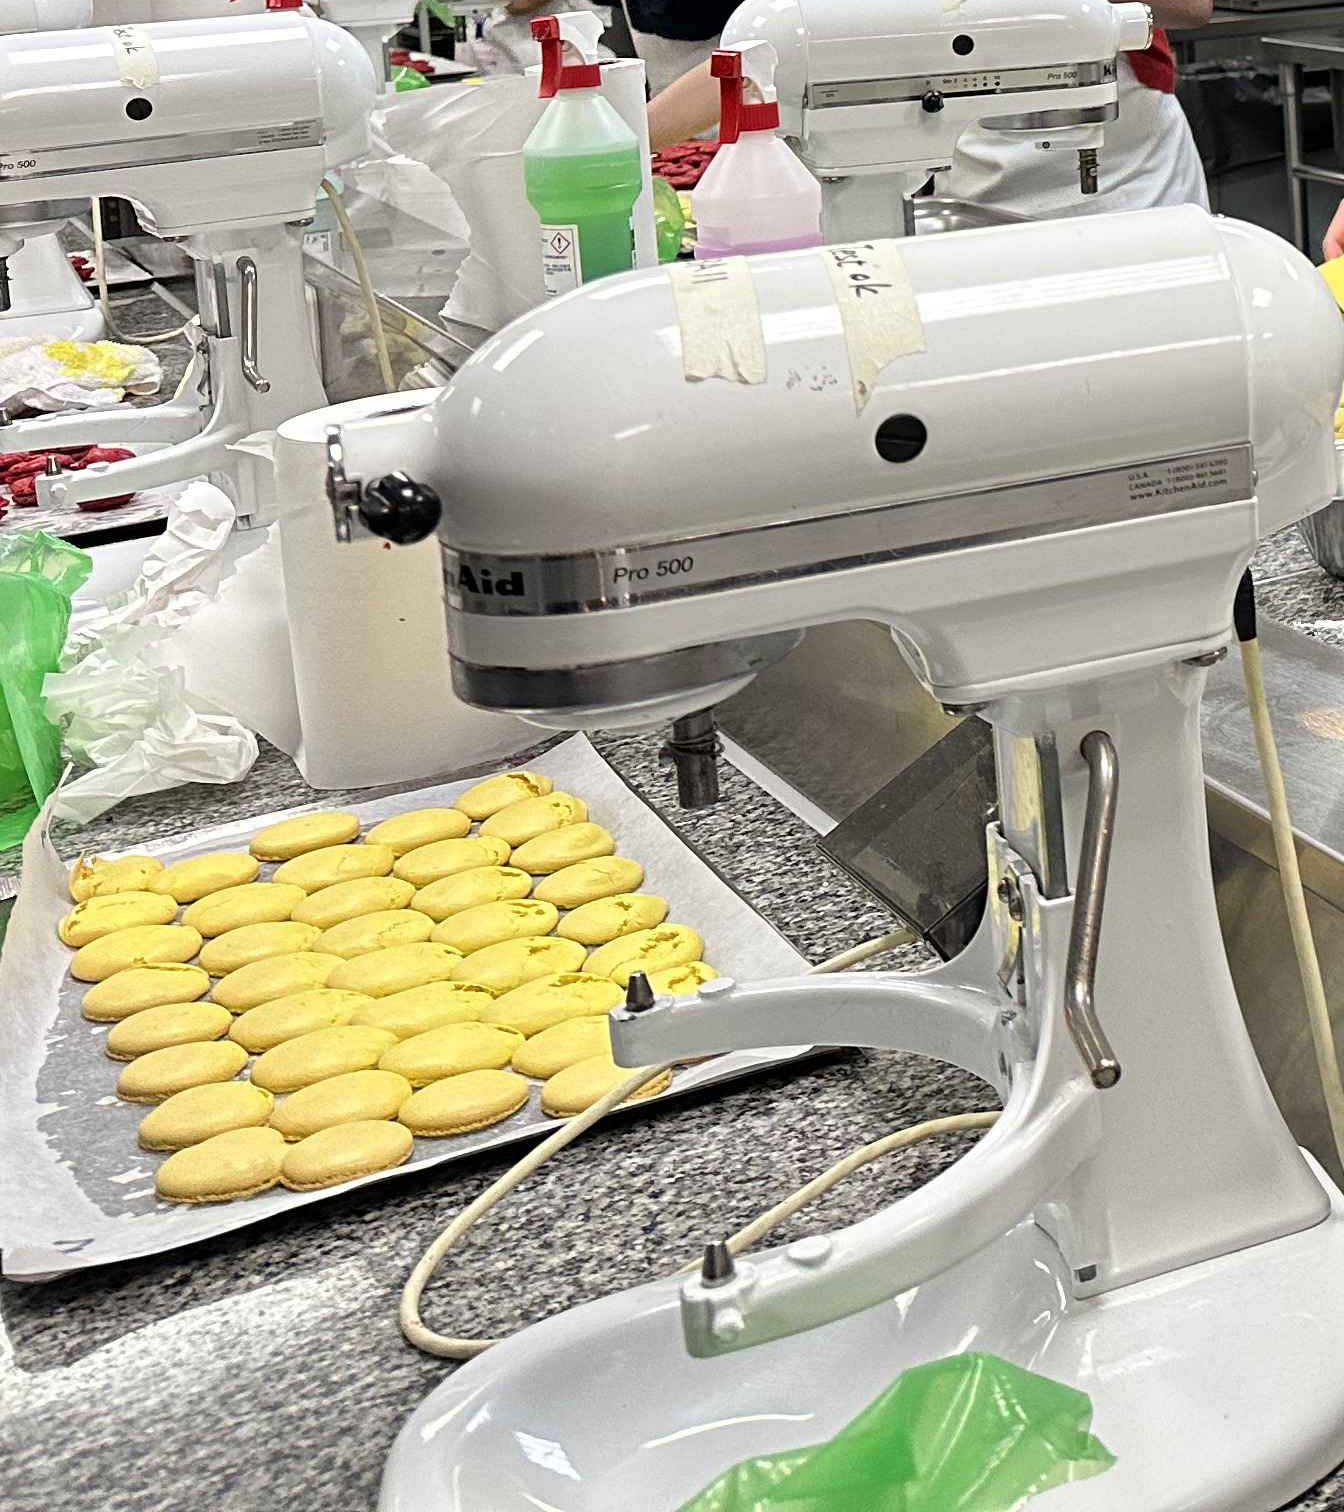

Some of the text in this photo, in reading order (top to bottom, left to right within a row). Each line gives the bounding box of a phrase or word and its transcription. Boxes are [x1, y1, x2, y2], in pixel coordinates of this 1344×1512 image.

[17, 159, 37, 169] 500
[848, 273, 893, 298] ok
[1129, 479, 1229, 501] www.KitchenAid.com
[613, 566, 650, 584] Pro
[656, 556, 695, 577] 500
